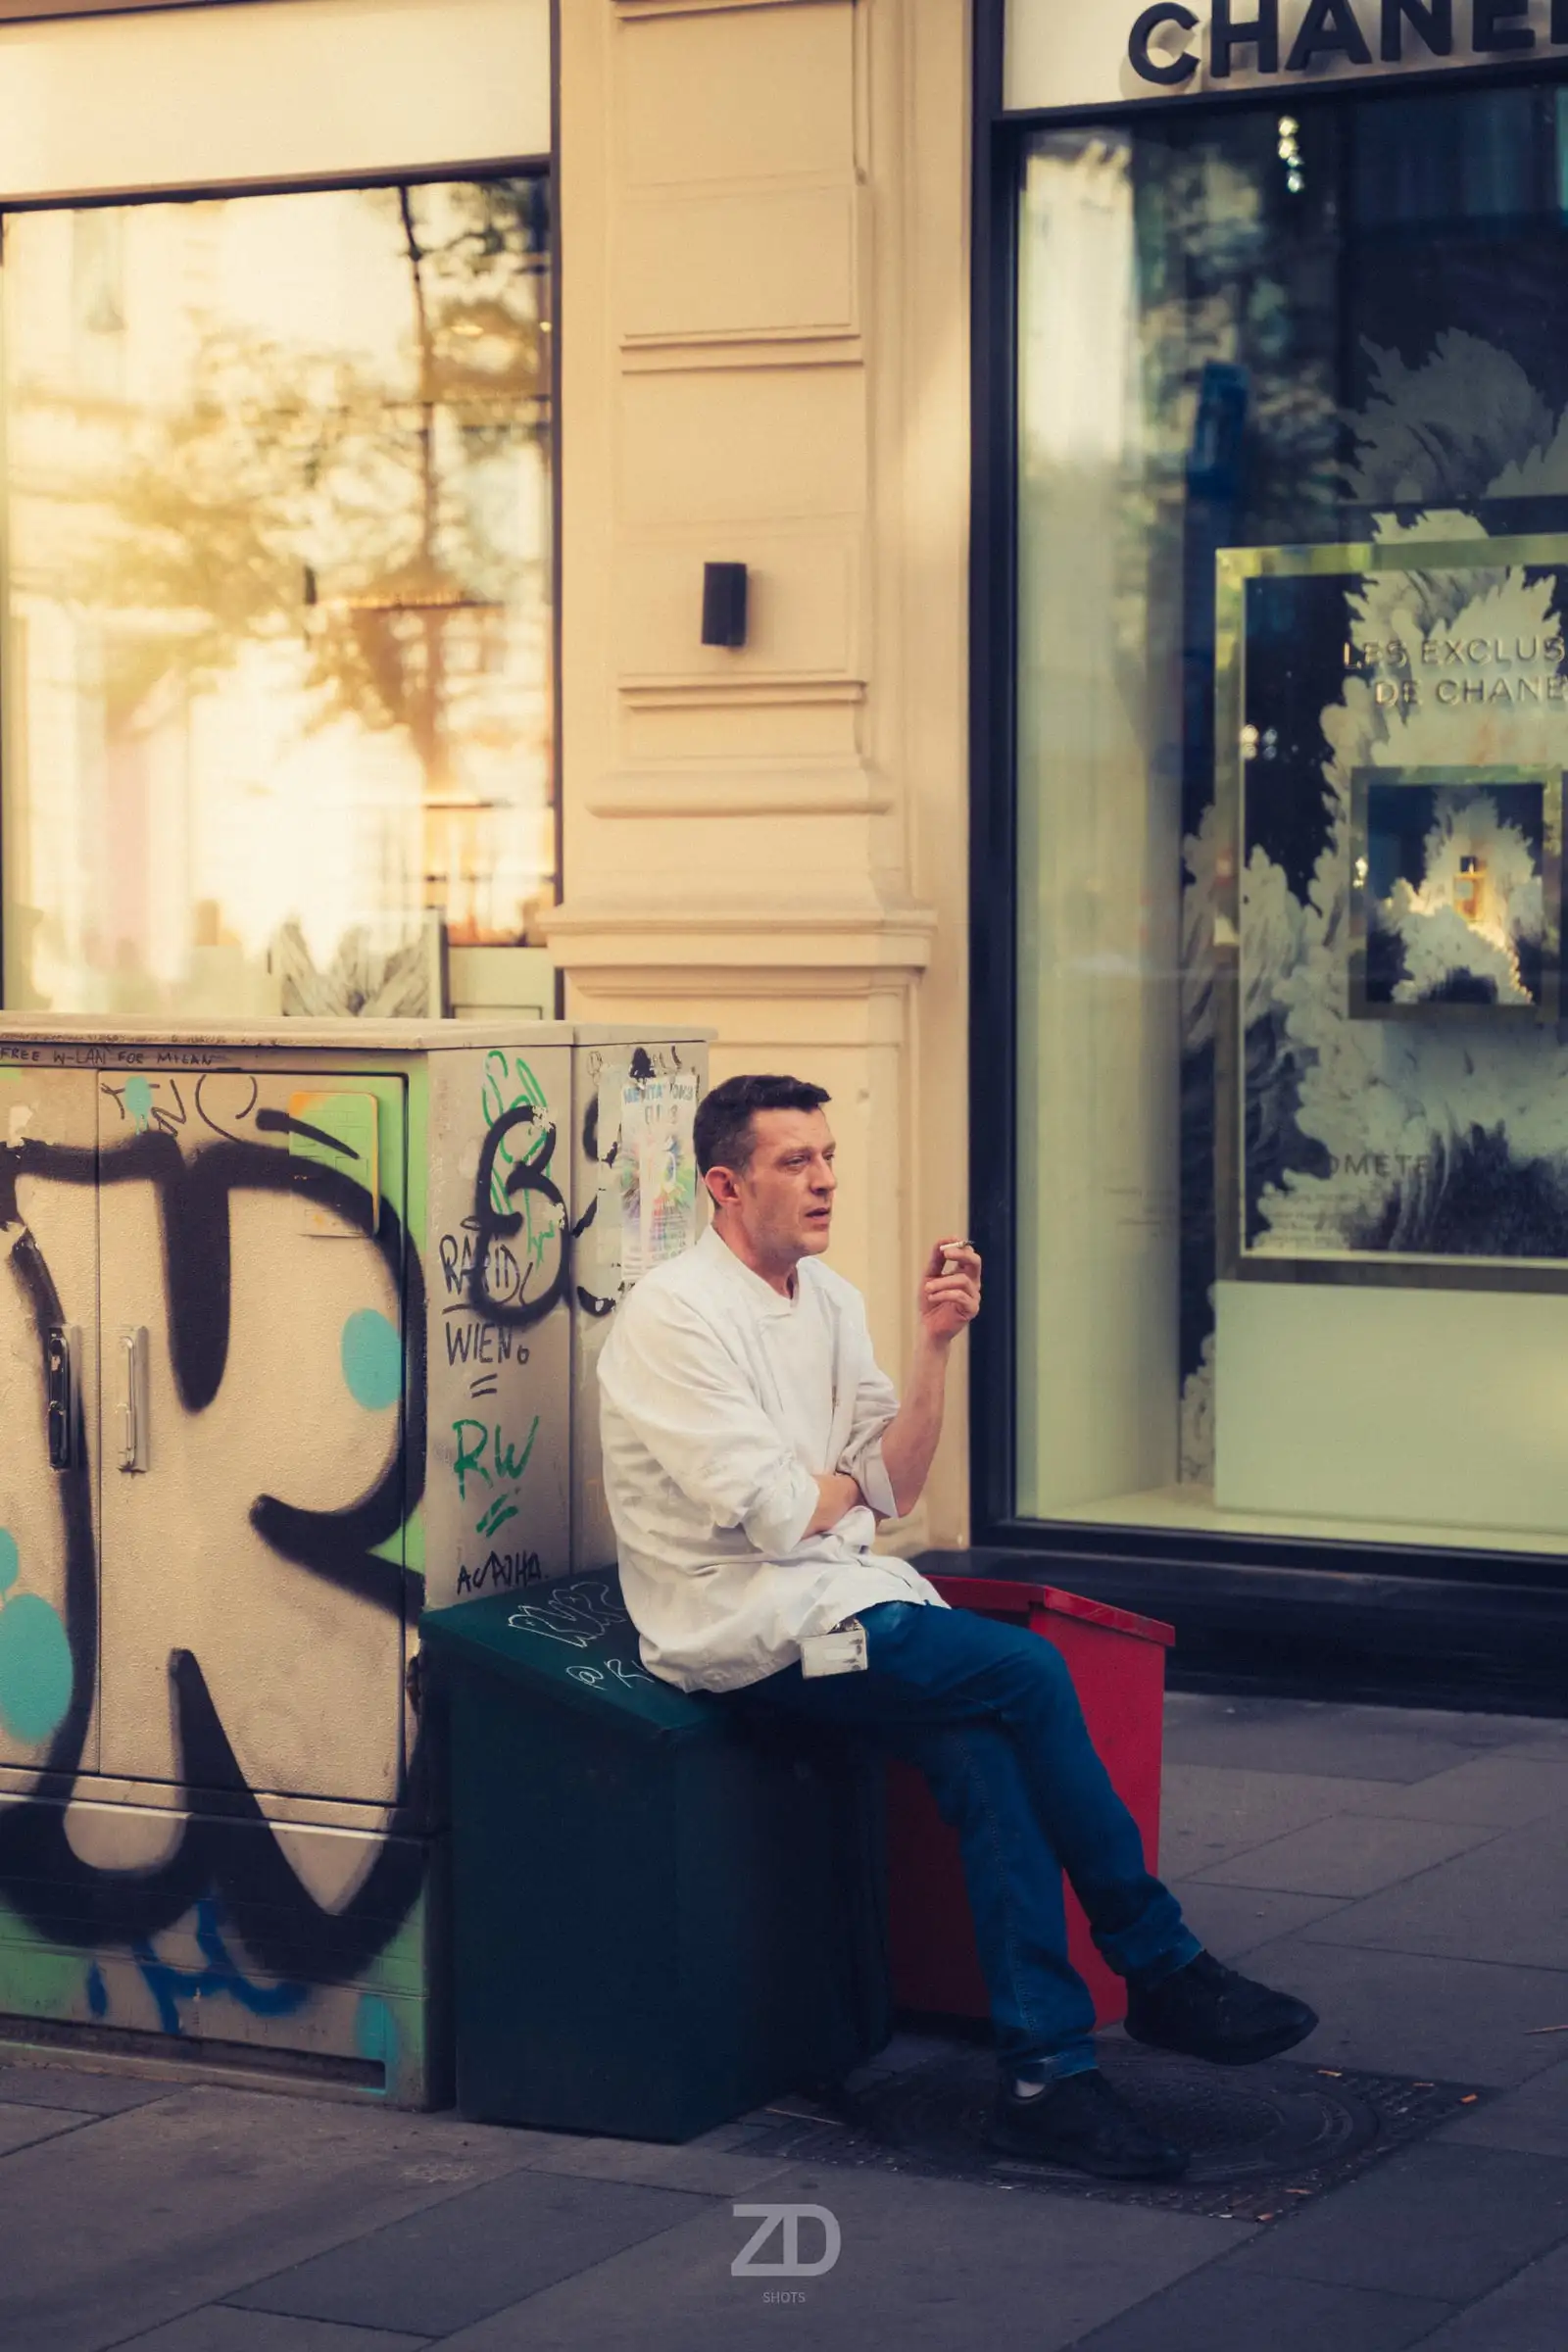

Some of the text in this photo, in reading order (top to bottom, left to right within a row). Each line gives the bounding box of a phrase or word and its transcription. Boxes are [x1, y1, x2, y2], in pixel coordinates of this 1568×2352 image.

[1344, 640, 1408, 670] LES
[1375, 679, 1424, 707] DE
[0, 1048, 40, 1061] FREE
[118, 1053, 144, 1065] FOR
[452, 1414, 541, 1502] RW
